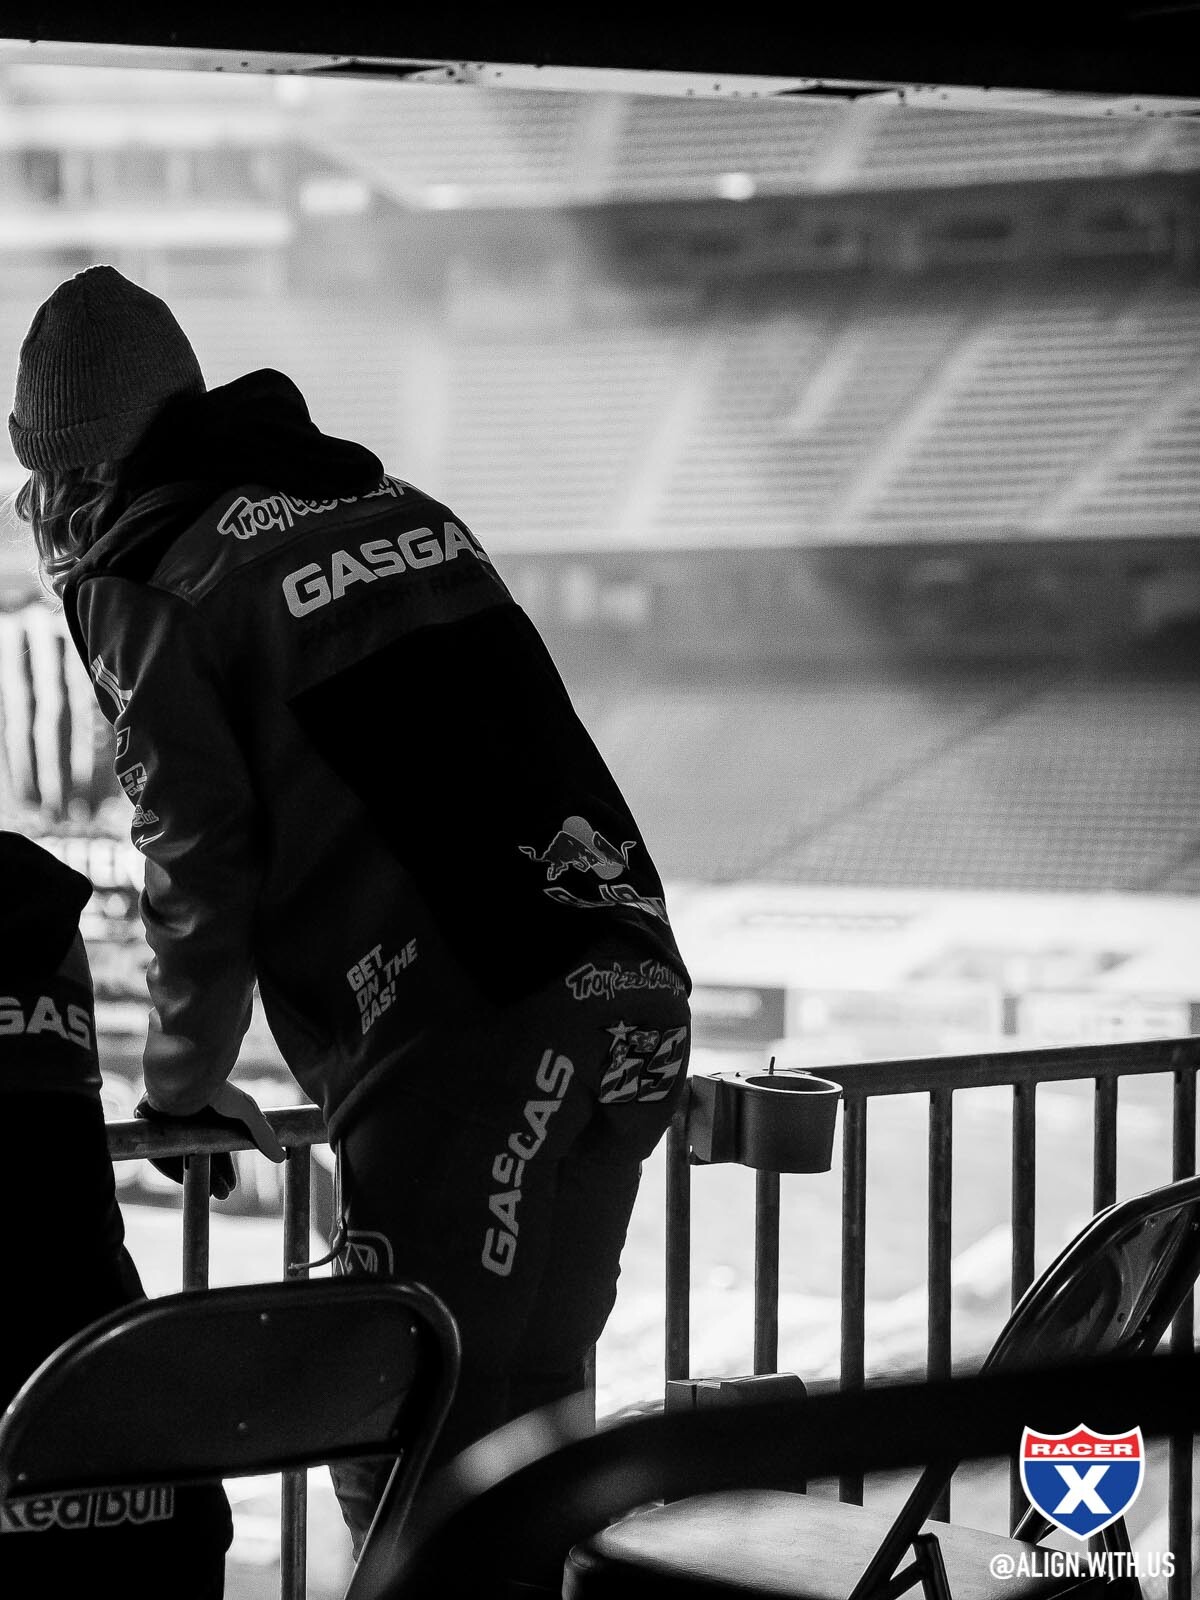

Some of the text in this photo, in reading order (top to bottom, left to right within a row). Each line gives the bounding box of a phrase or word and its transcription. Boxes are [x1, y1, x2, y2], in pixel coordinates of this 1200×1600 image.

[217, 496, 294, 539] Troy
[346, 944, 382, 991] GET
[356, 938, 418, 1014] ON THE
[565, 963, 616, 1000] Troy
[361, 980, 397, 1035] GAS!
